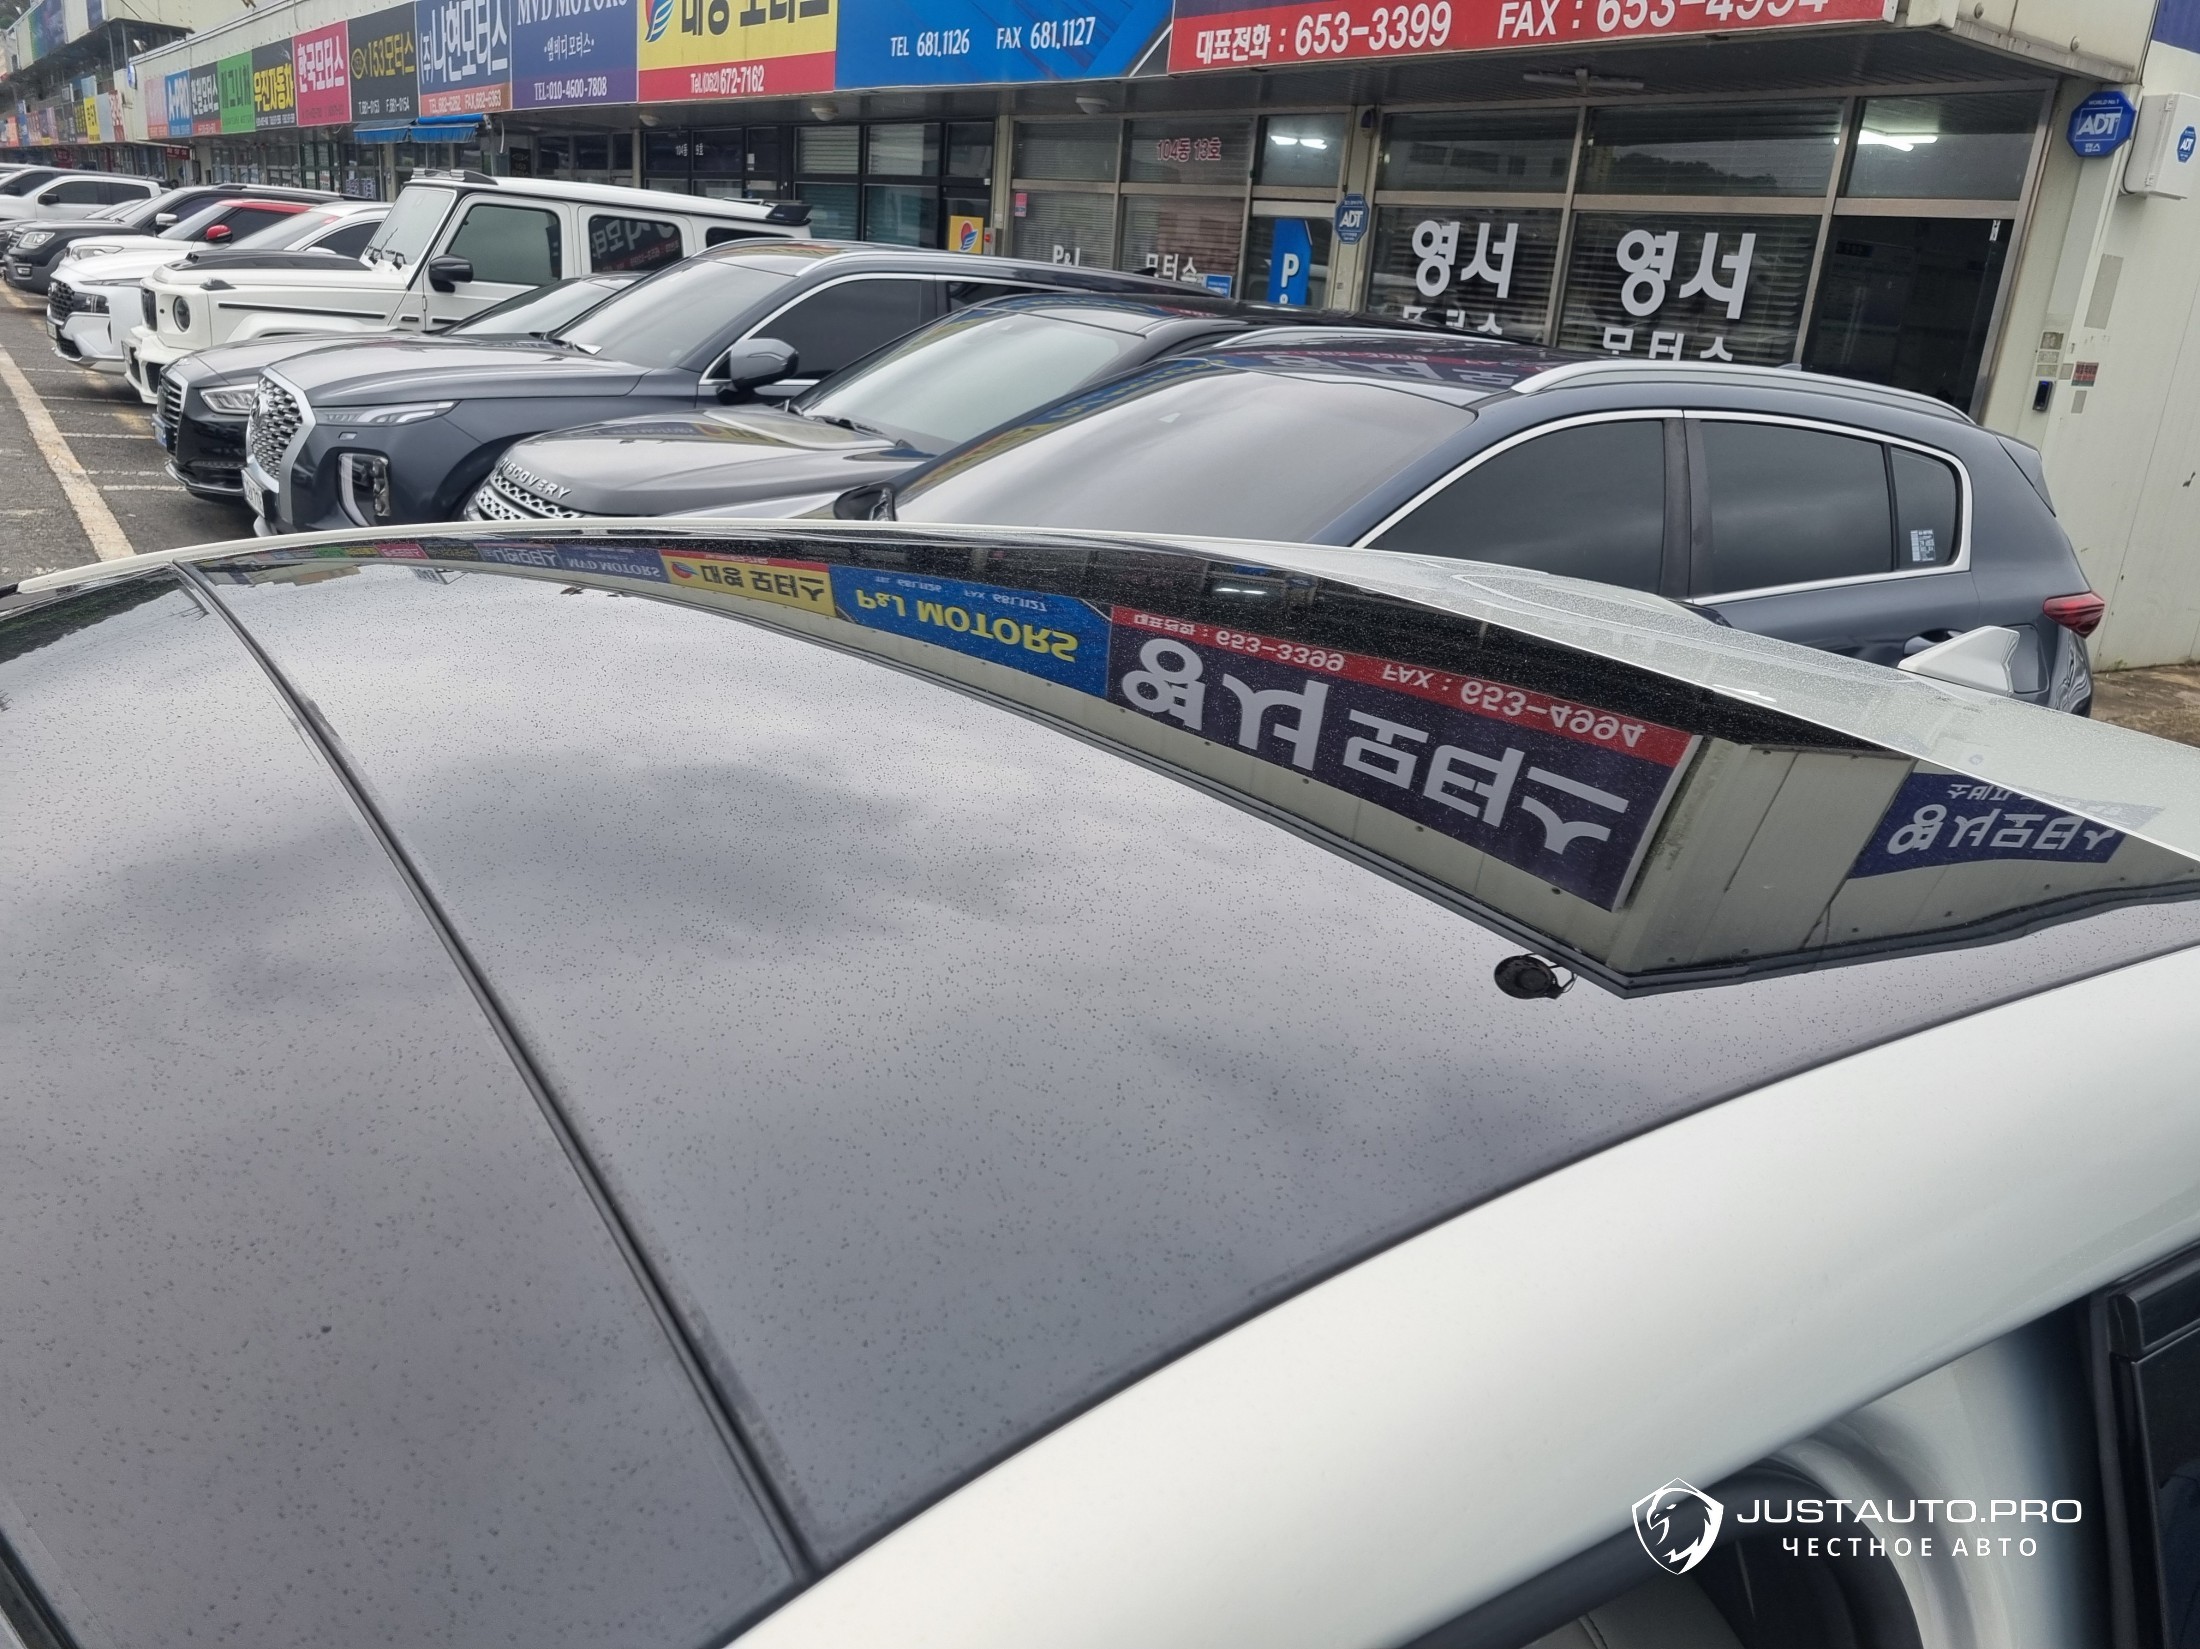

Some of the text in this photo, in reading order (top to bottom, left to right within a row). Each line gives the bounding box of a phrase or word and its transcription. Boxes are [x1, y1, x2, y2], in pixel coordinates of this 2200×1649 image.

[1196, 24, 1270, 64] 대표전화
[1295, 1, 1451, 56] 653-3399
[1497, 0, 1557, 39] FAX
[890, 37, 909, 57] TEL
[996, 27, 1022, 50] FAX
[2076, 113, 2121, 135] ADT
[1157, 136, 1221, 162] 104동 13호
[1339, 210, 1364, 228] ADT
[1281, 252, 1300, 288] P
[1411, 220, 1519, 299] 영서
[1616, 229, 1756, 320] 영서
